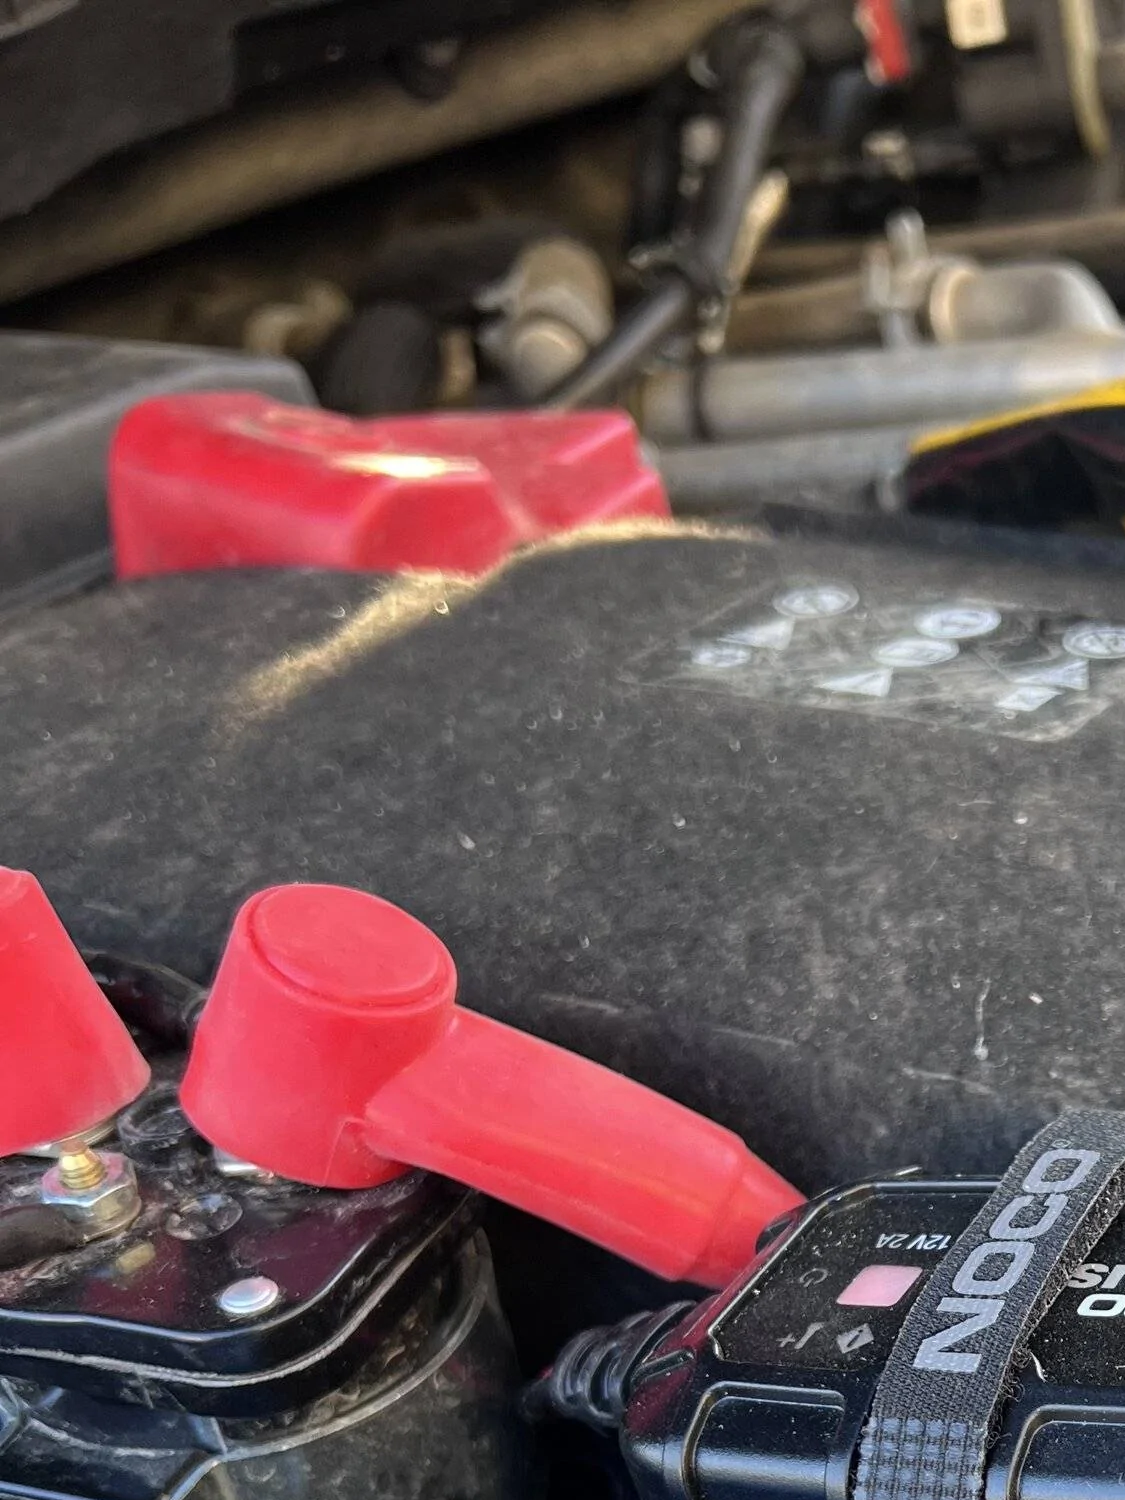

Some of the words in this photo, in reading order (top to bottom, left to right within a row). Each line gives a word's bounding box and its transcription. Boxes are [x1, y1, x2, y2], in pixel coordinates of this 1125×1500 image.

[875, 1233, 909, 1250] 2A
[906, 1234, 952, 1250] 12V
[913, 1149, 1100, 1373] NOCO
